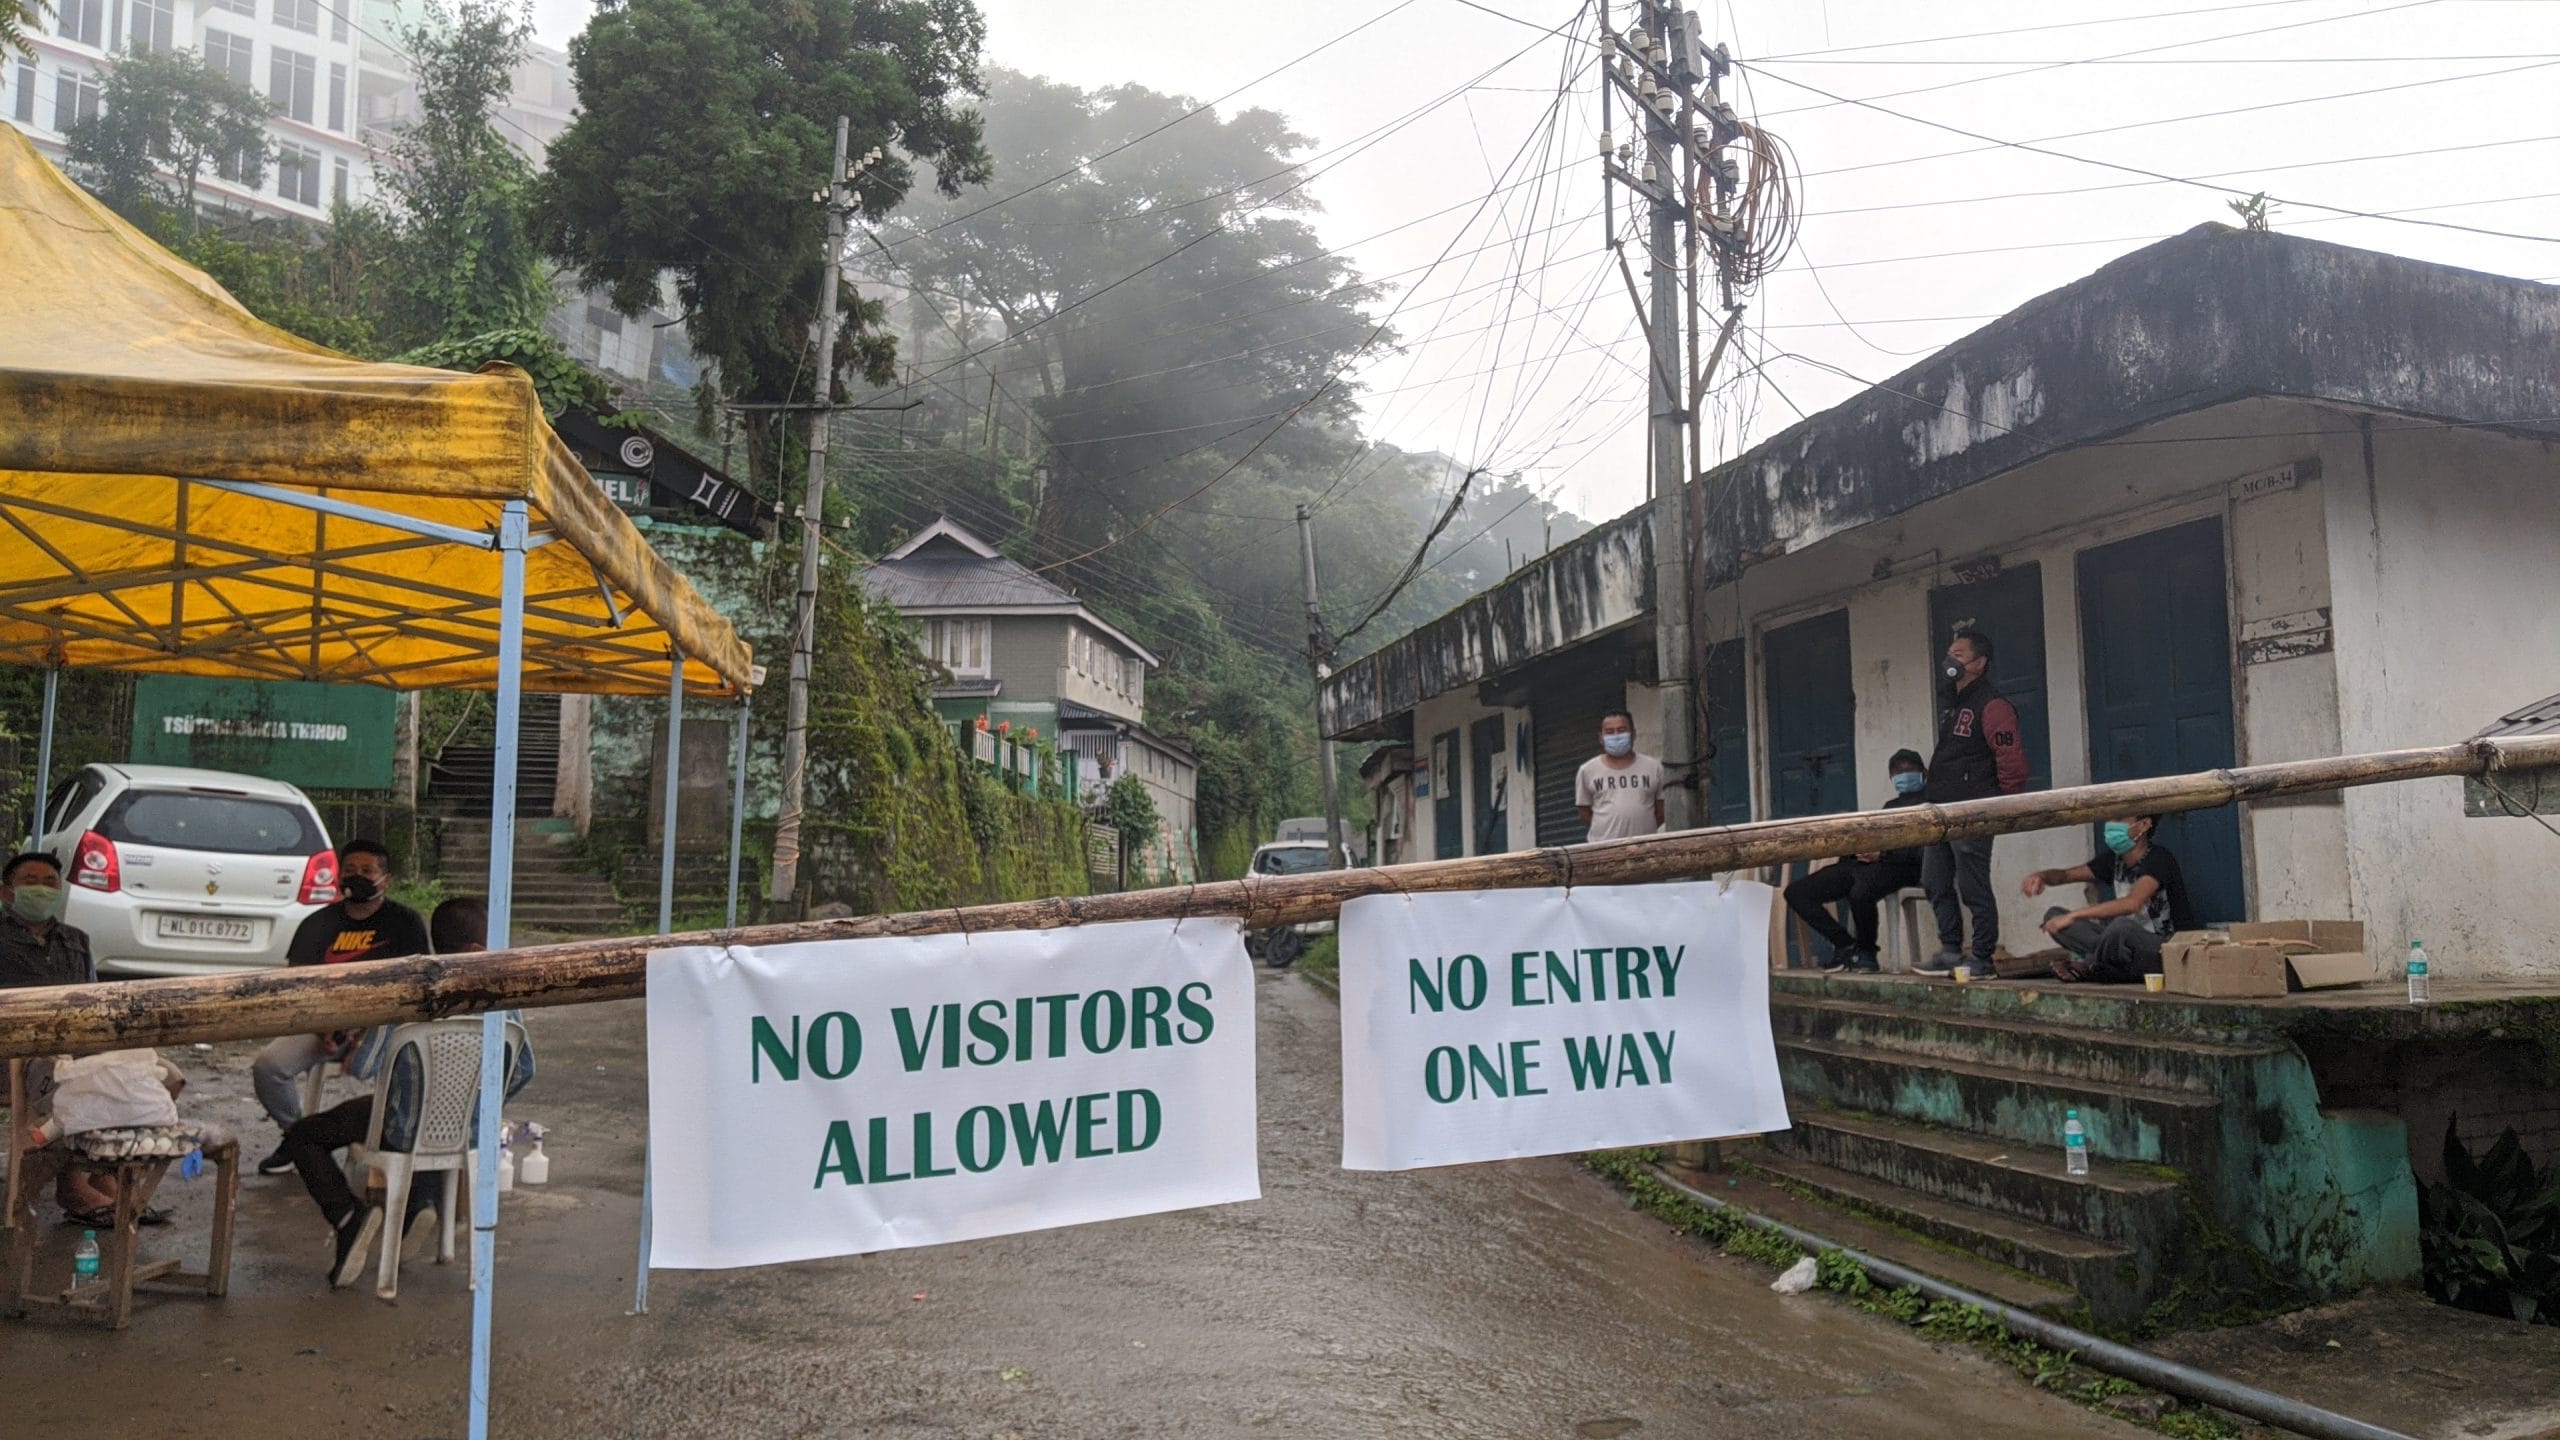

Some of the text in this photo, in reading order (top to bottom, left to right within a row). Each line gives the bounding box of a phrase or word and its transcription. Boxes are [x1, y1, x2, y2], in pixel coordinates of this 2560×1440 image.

[1953, 707, 1975, 738] R
[1593, 774, 1650, 791] WROGN
[333, 929, 377, 951] NIKE
[1409, 944, 1686, 1014] NO ENTRY
[751, 981, 1215, 1084] NO VISITORS
[1424, 1030, 1676, 1104] ONE WAY
[813, 1088, 1162, 1189] ALLOWED
